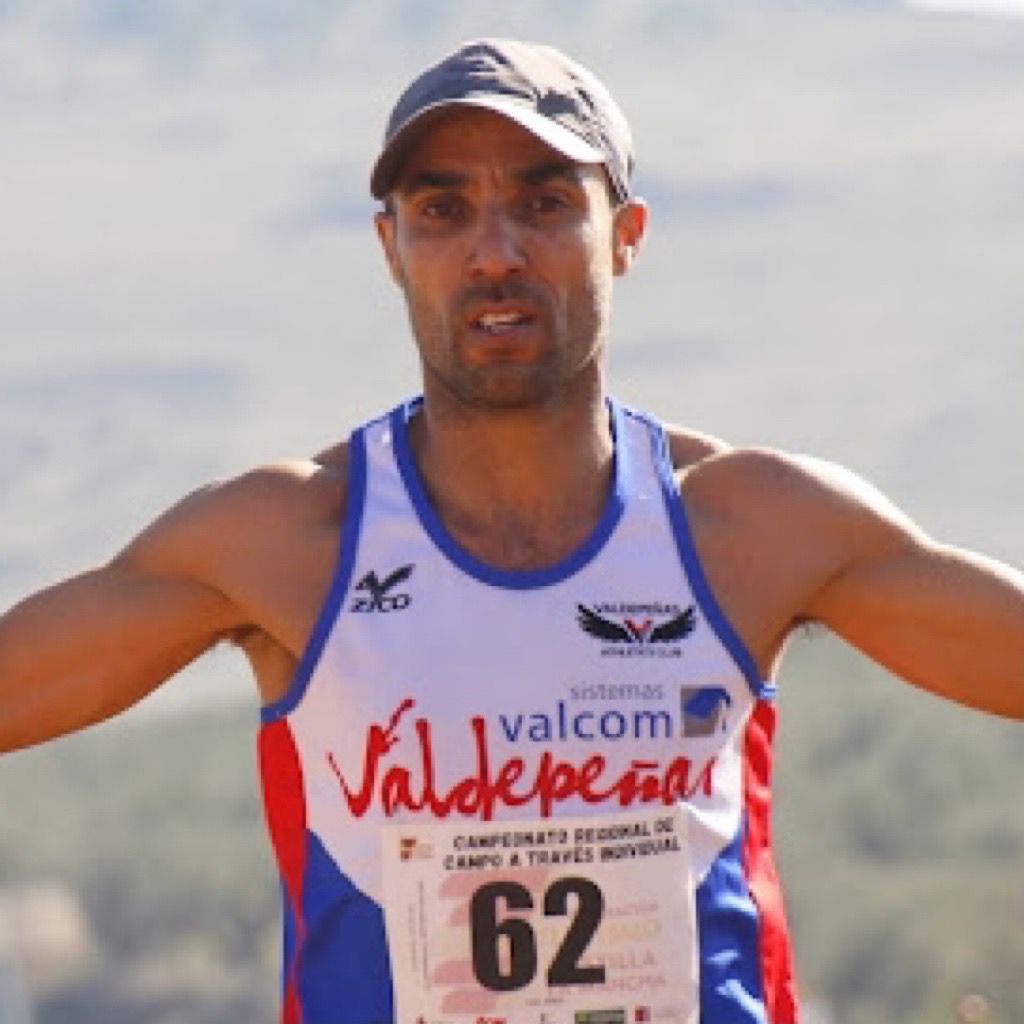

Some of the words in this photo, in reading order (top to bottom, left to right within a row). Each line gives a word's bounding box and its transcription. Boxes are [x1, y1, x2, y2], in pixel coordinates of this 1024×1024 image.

[570, 682, 665, 700] sistemas
[499, 702, 672, 743] valcom
[442, 852, 504, 872] CAMPO
[470, 876, 606, 992] 62
